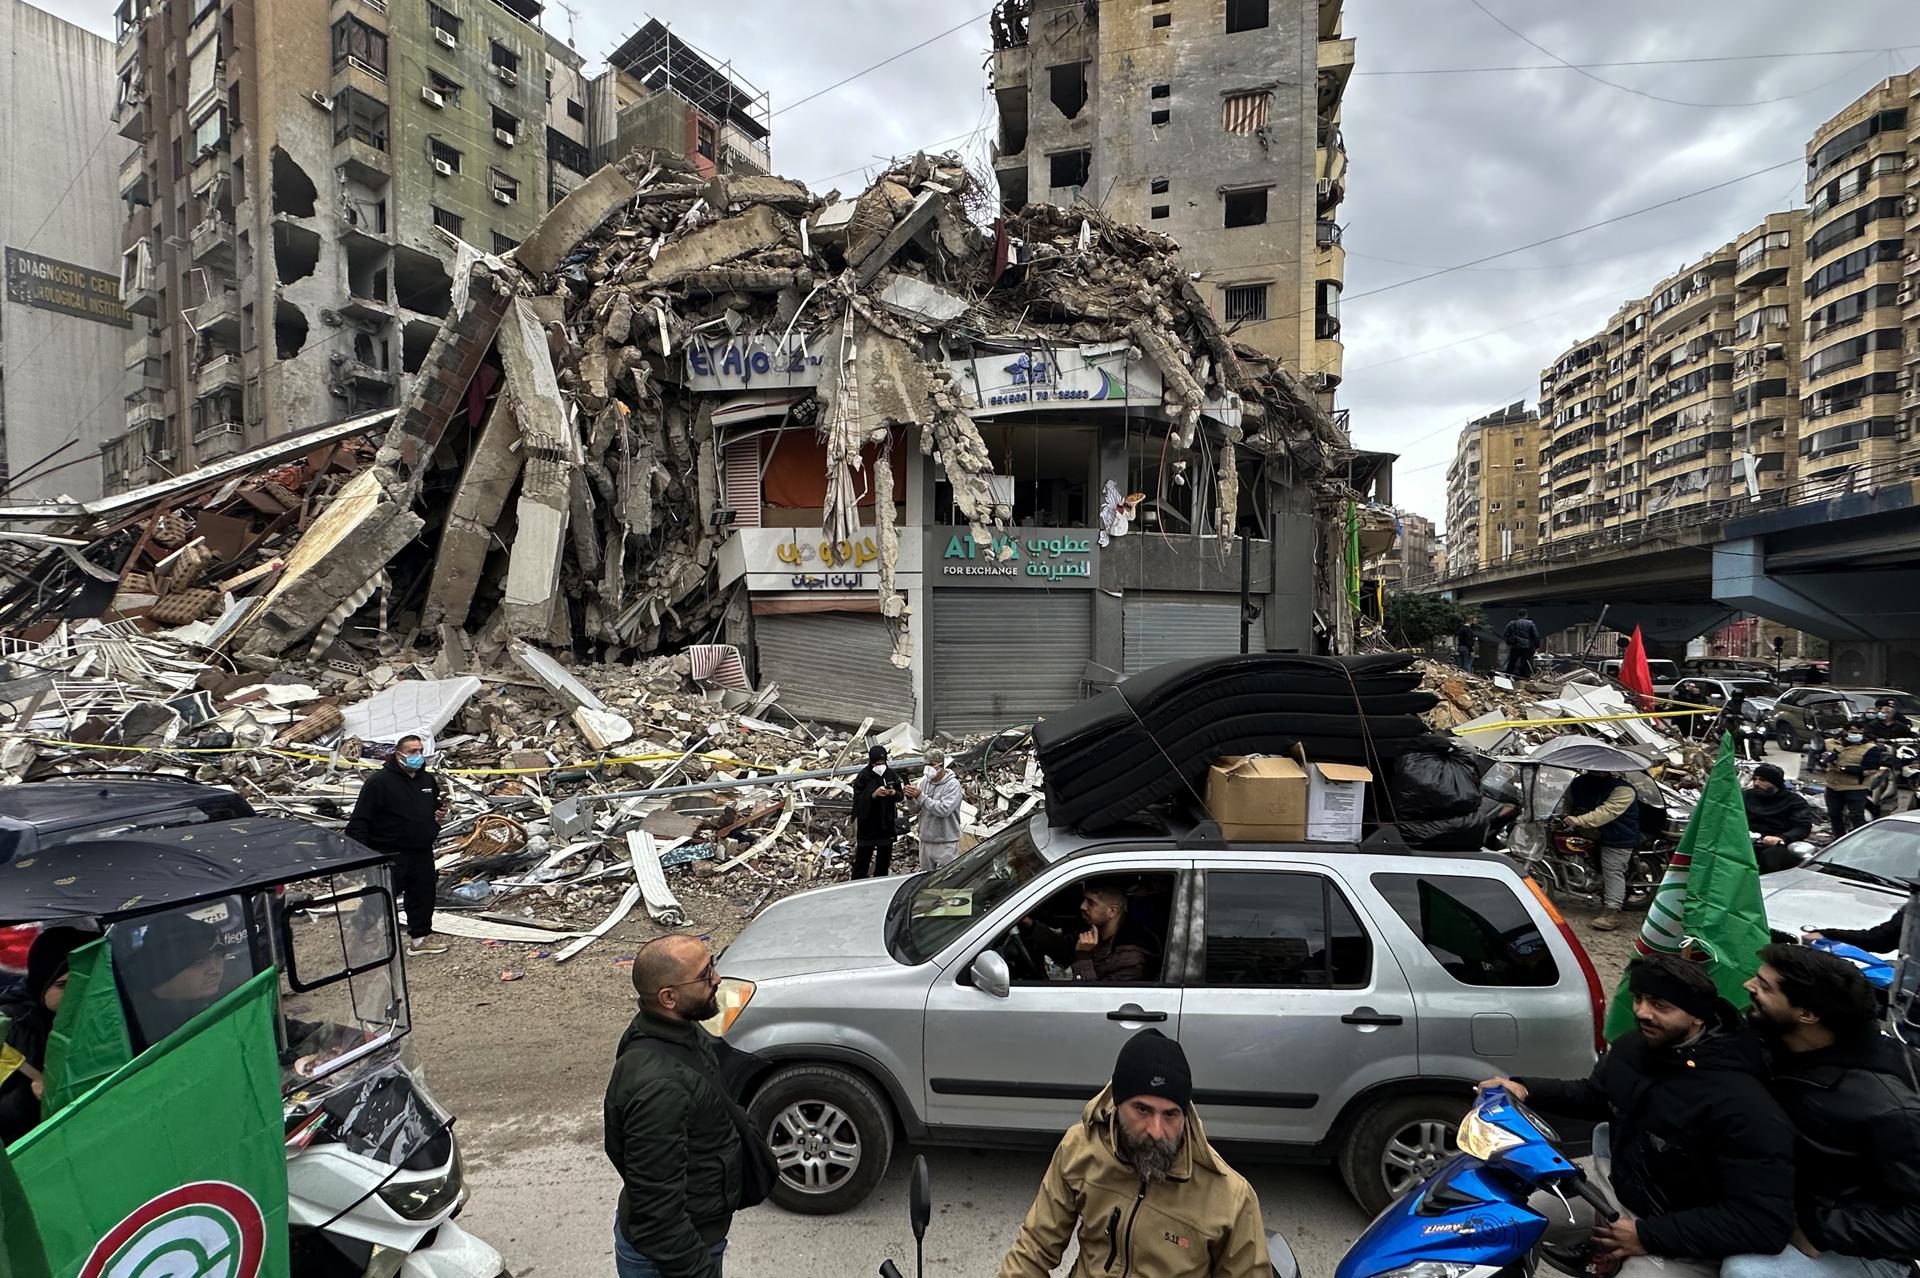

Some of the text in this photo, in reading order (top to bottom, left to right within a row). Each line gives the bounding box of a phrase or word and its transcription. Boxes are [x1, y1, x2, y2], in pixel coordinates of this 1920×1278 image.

[19, 257, 86, 289] DIAGNOSTIC
[90, 297, 132, 321] INSTITUTE
[1027, 534, 1091, 558] عطوي
[943, 566, 1018, 576] FOR EXCHANGE
